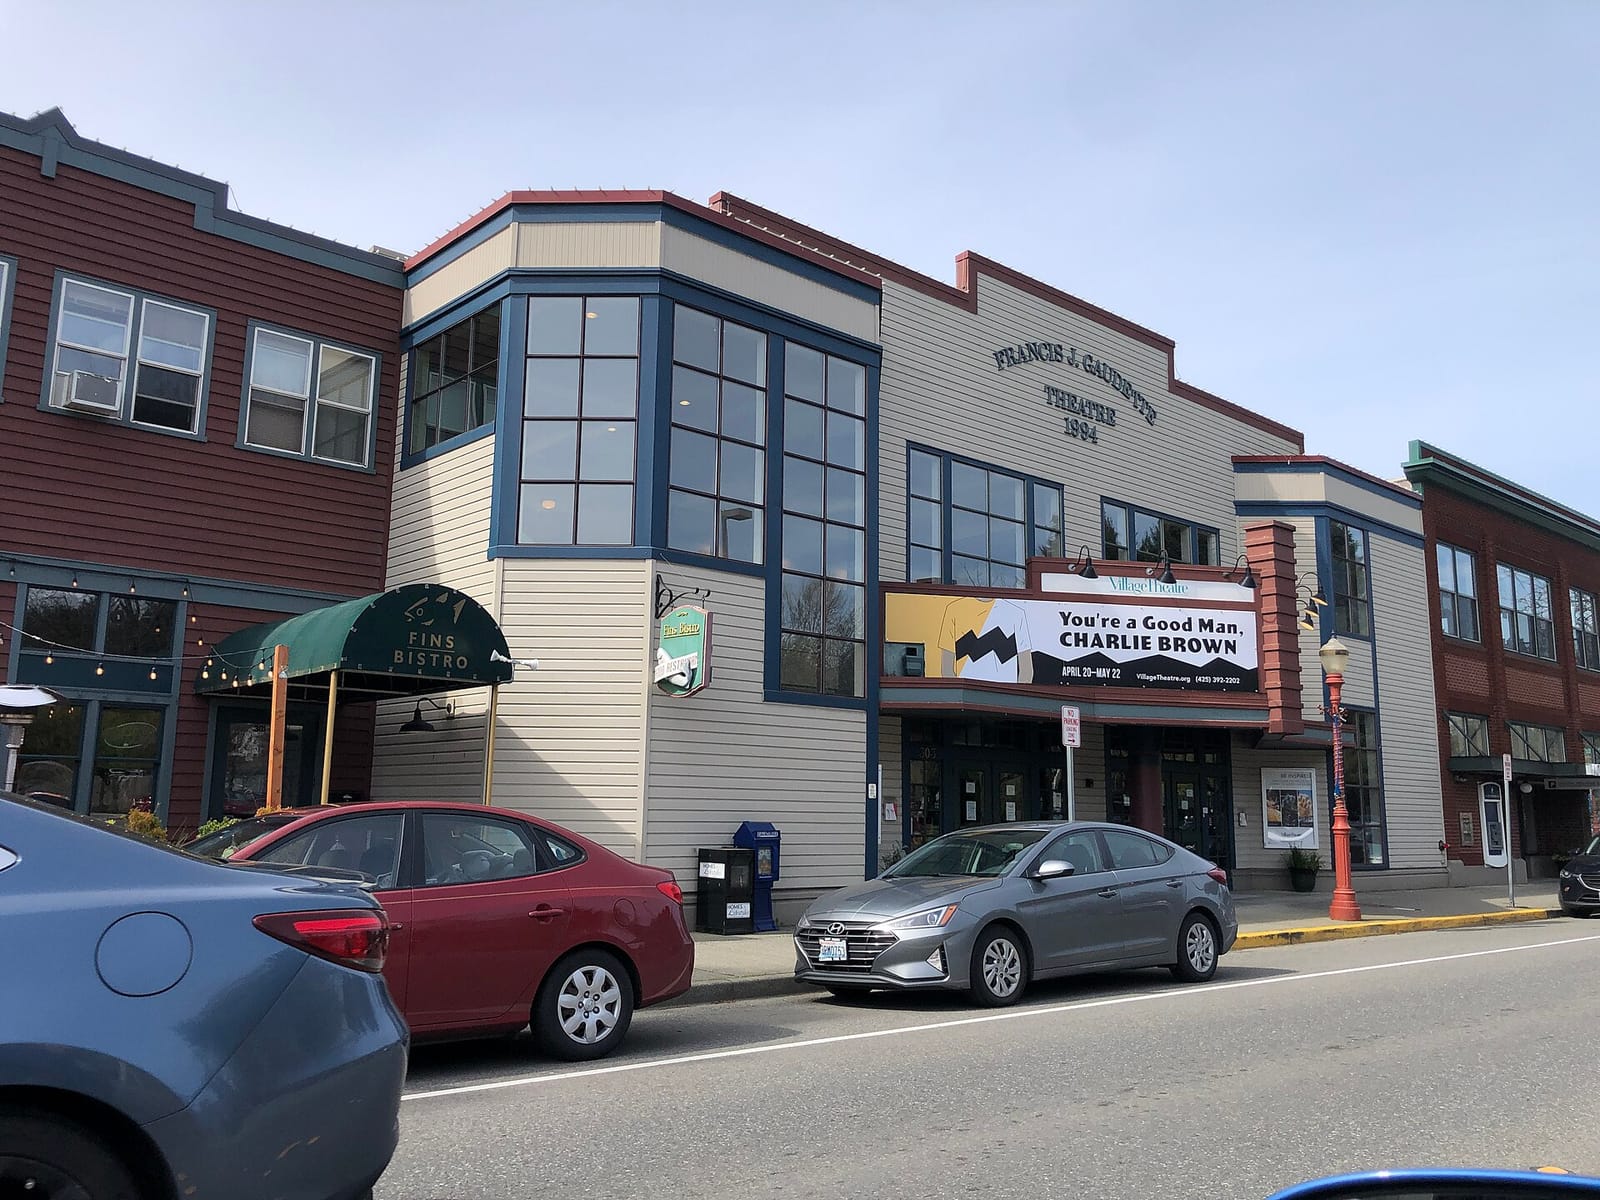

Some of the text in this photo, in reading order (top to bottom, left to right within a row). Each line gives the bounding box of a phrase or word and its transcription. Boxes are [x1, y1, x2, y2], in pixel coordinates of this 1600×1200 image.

[993, 342, 1157, 426] FRANCIS J. GAUDETTE
[1044, 385, 1117, 427] THEATRE
[1064, 417, 1098, 443] 1994
[1059, 611, 1244, 637] You're a Good Man,
[409, 631, 455, 649] FINS
[1059, 631, 1237, 655] CHARLIE BROWN
[394, 650, 468, 669] BISTRO
[1062, 666, 1081, 678] APRIL
[1111, 668, 1121, 679] 22
[1136, 673, 1191, 684] VillageTheatre.org
